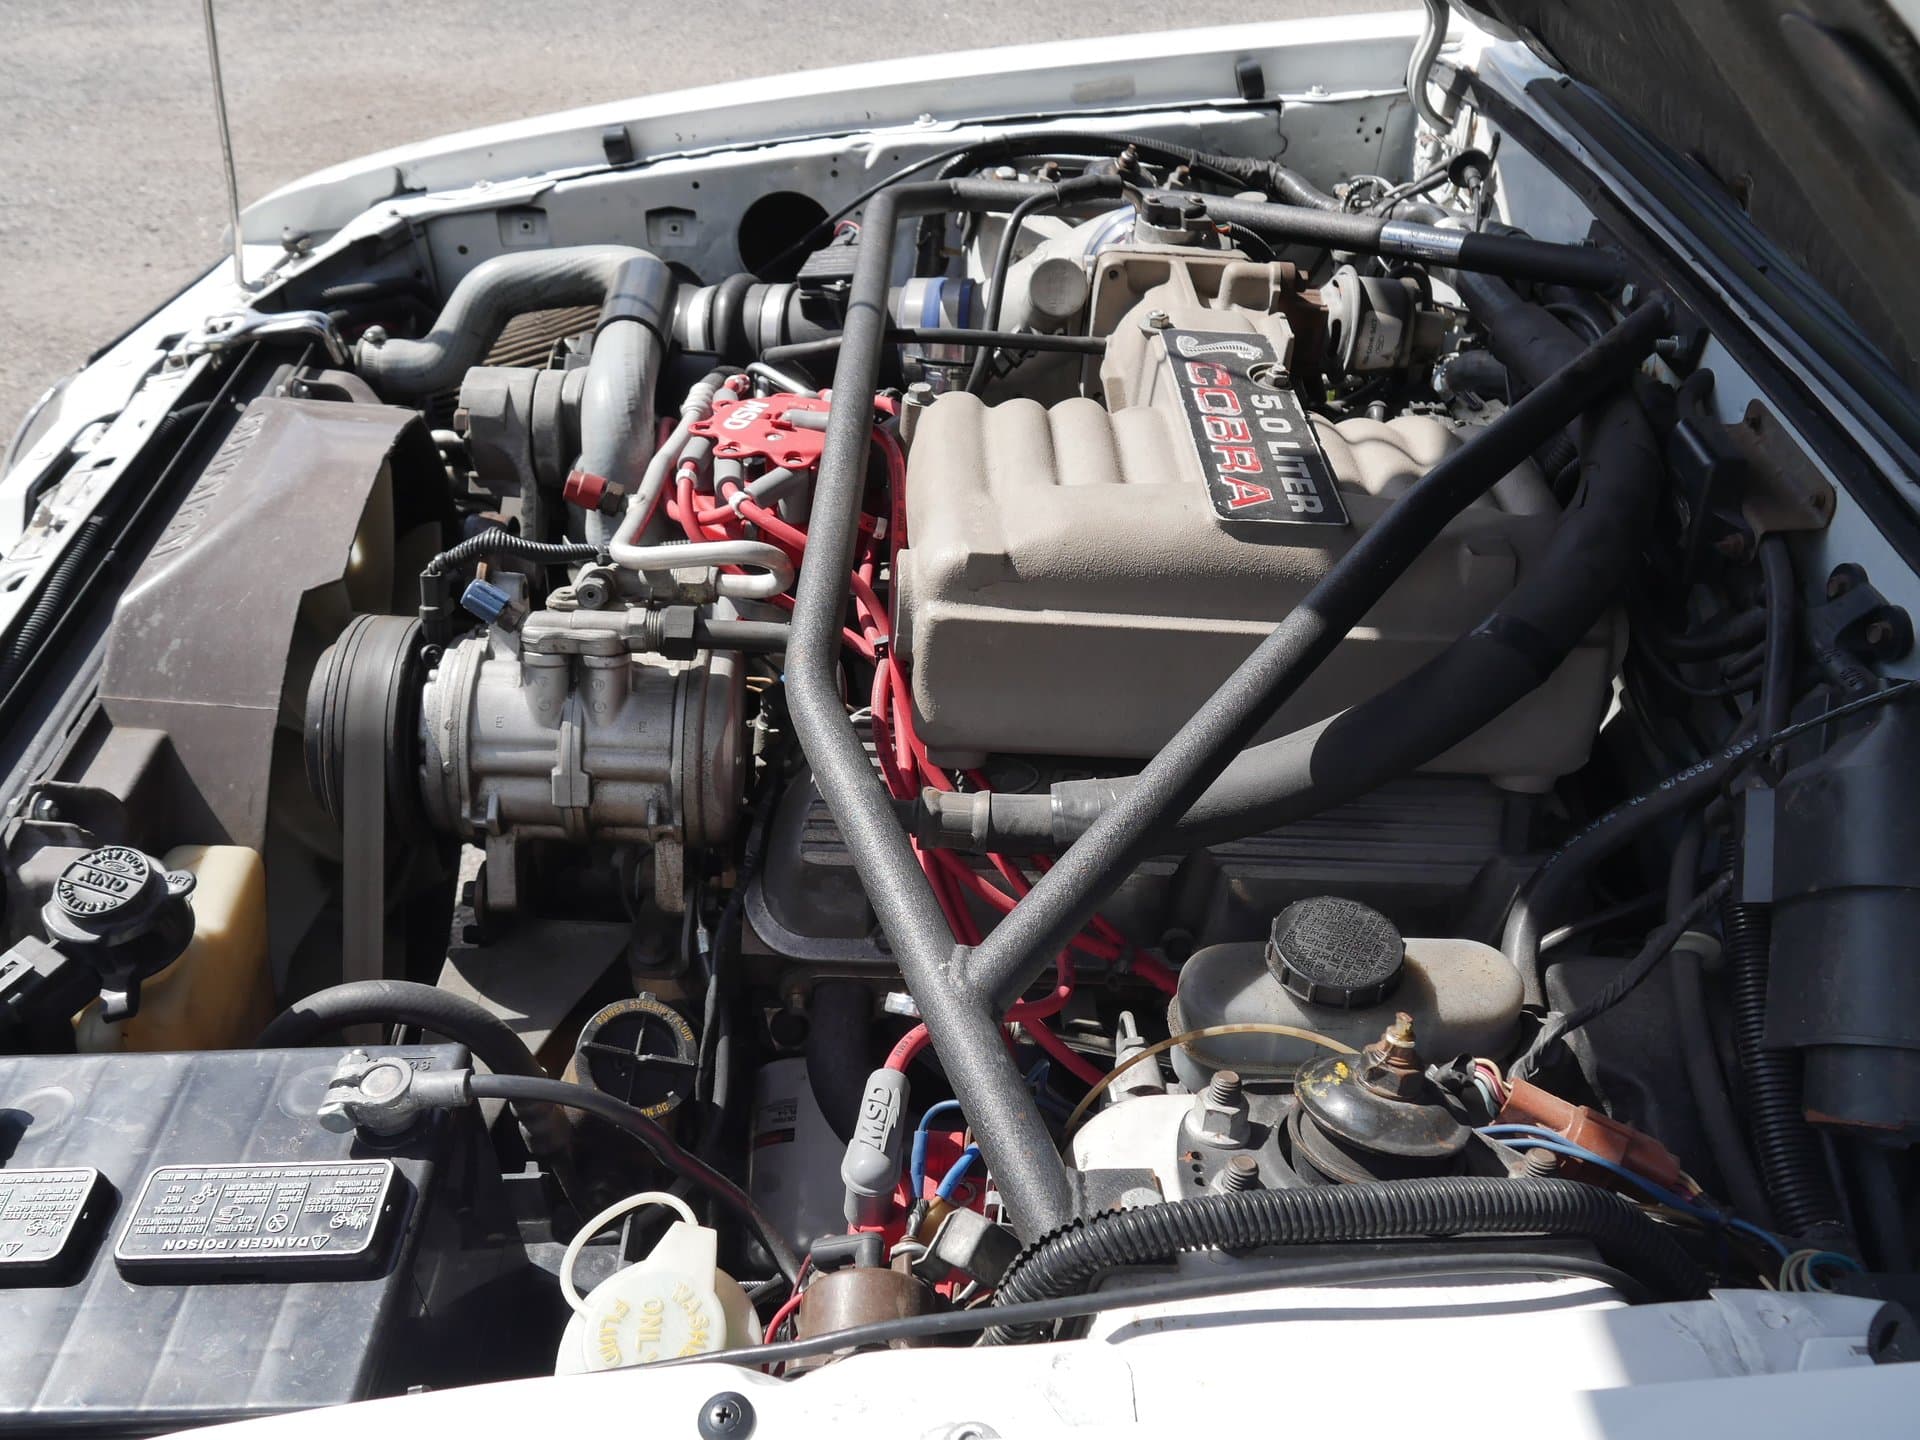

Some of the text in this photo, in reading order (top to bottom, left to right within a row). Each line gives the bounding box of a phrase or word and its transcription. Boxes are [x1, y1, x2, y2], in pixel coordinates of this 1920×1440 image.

[723, 400, 770, 430] MSD
[1185, 361, 1274, 510] COBRA
[1250, 394, 1324, 513] 5.0 LITER
[595, 1002, 626, 1025] POWER
[859, 1086, 894, 1150] MSD
[214, 1224, 254, 1233] SULFURIC
[670, 1280, 710, 1358] WASHE
